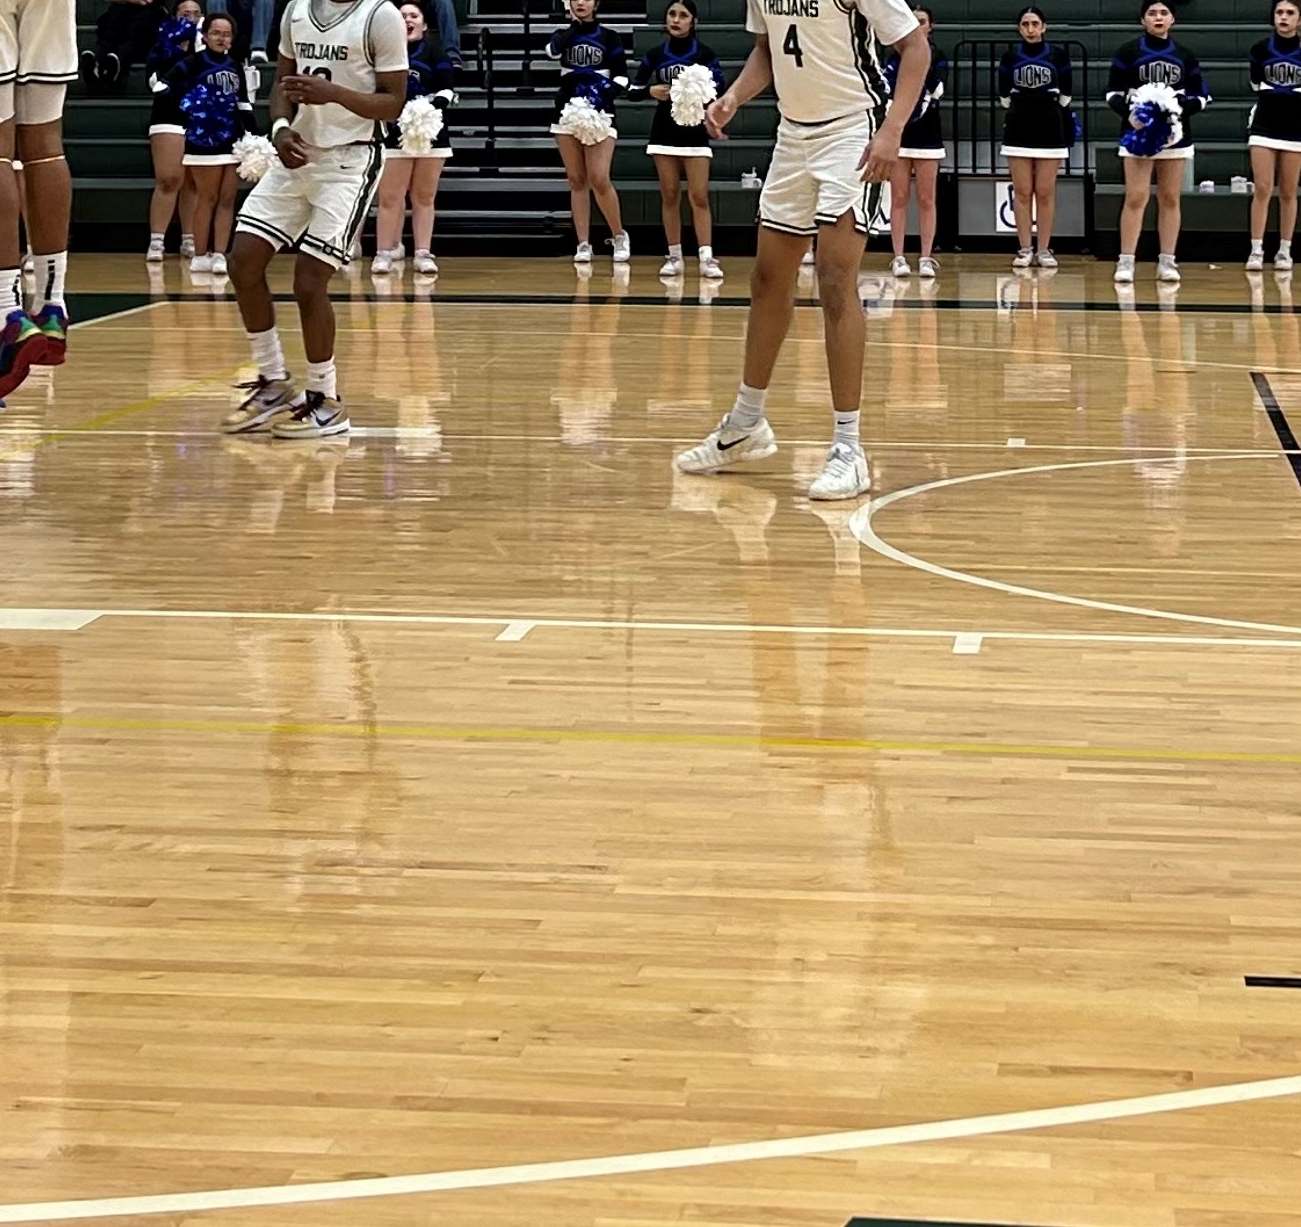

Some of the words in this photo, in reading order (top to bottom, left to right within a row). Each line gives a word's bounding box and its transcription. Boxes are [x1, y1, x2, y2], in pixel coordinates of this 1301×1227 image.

[294, 42, 349, 61] TROJANS
[565, 43, 604, 68] LIONS
[783, 24, 803, 68] 4
[1013, 65, 1052, 89] LIONS
[1138, 60, 1182, 85] LIONS
